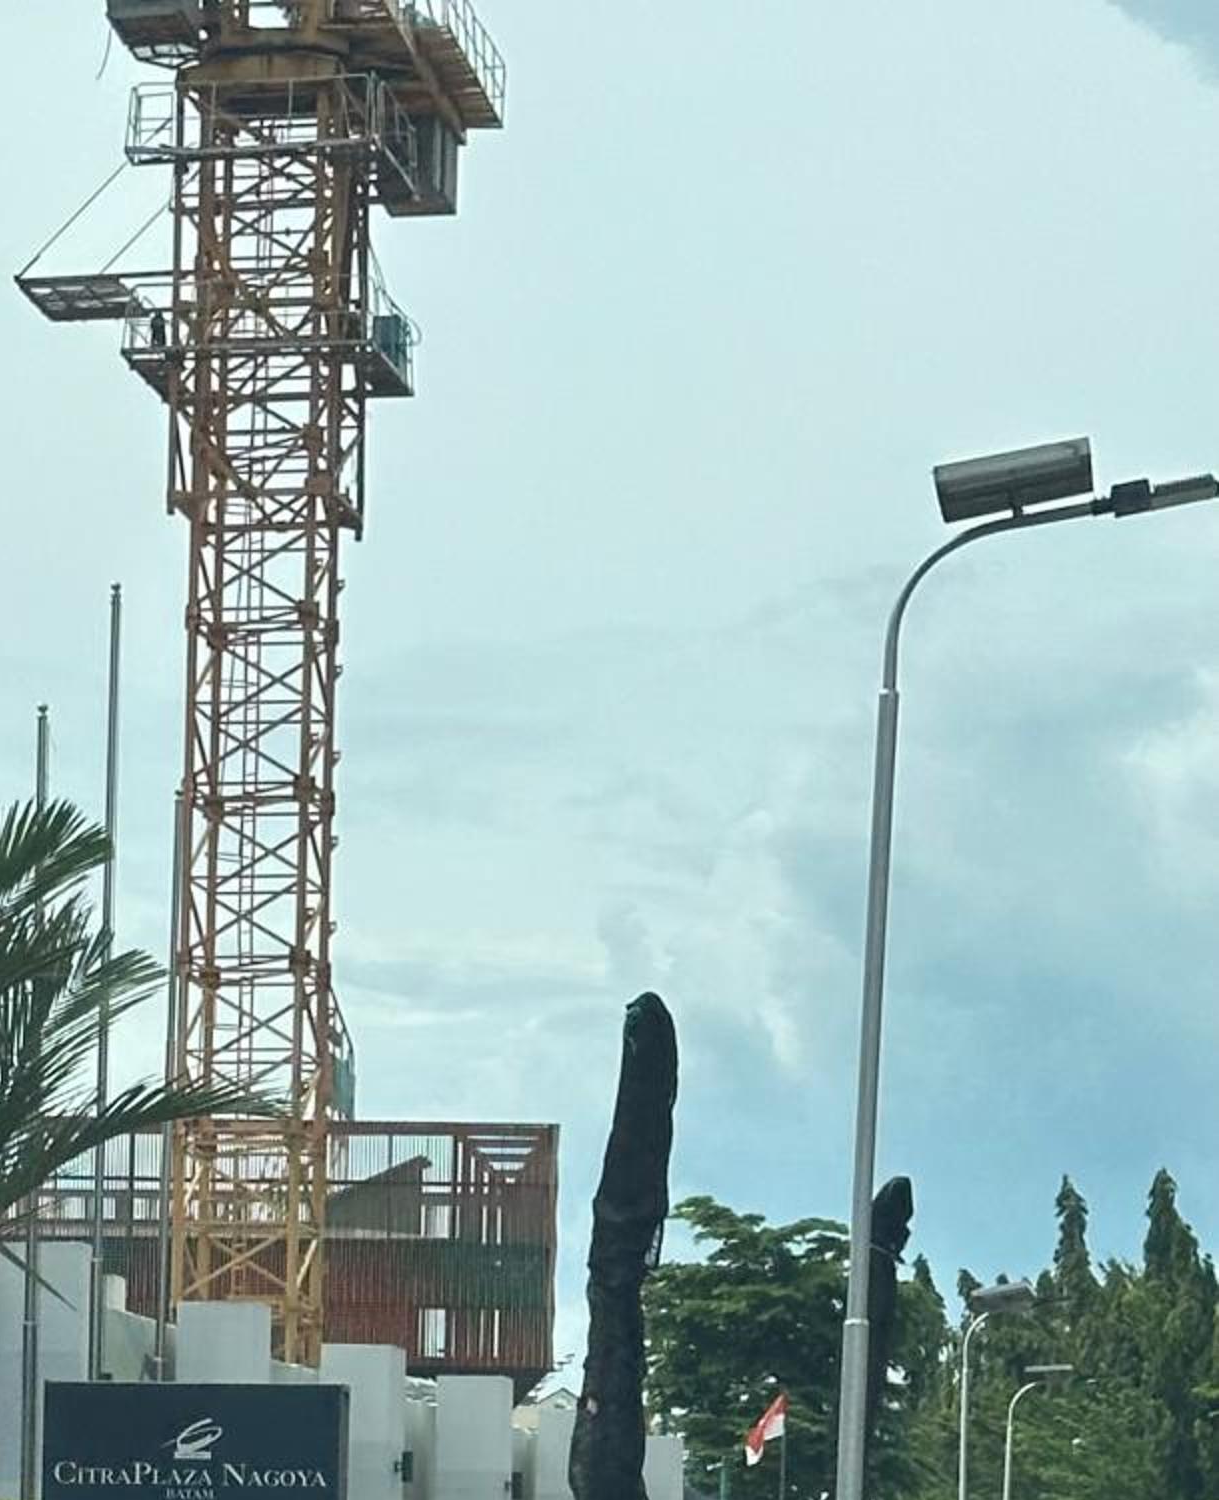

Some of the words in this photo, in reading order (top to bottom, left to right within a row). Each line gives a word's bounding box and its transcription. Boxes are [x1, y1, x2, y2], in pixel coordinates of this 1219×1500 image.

[53, 1460, 213, 1487] CITRAPLAZA
[222, 1463, 327, 1488] NAGOYA
[165, 1488, 215, 1500] BATAM
